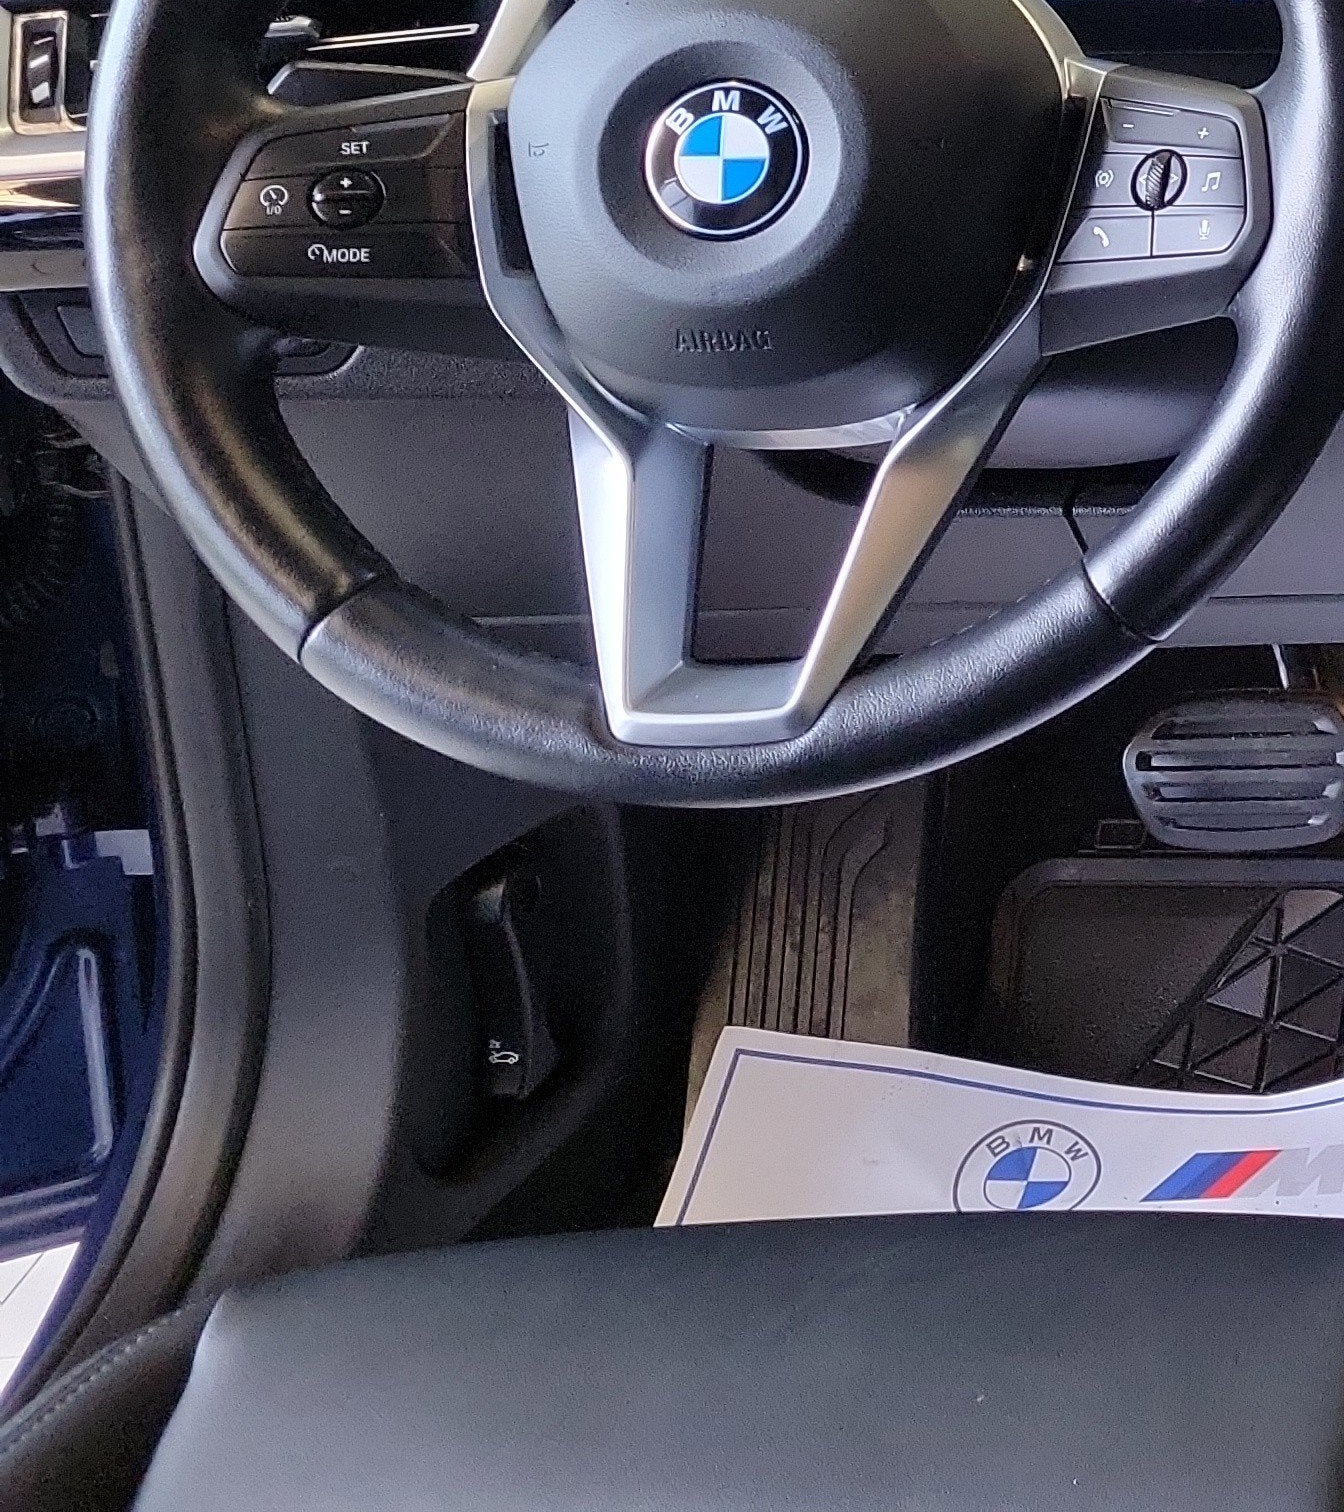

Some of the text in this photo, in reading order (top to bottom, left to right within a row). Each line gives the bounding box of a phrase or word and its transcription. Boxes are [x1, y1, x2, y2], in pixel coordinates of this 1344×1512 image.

[665, 90, 789, 136] BMW
[340, 141, 370, 155] SET
[323, 248, 371, 263] MODE
[675, 328, 773, 352] AIRBAG
[984, 1125, 1091, 1163] BMW
